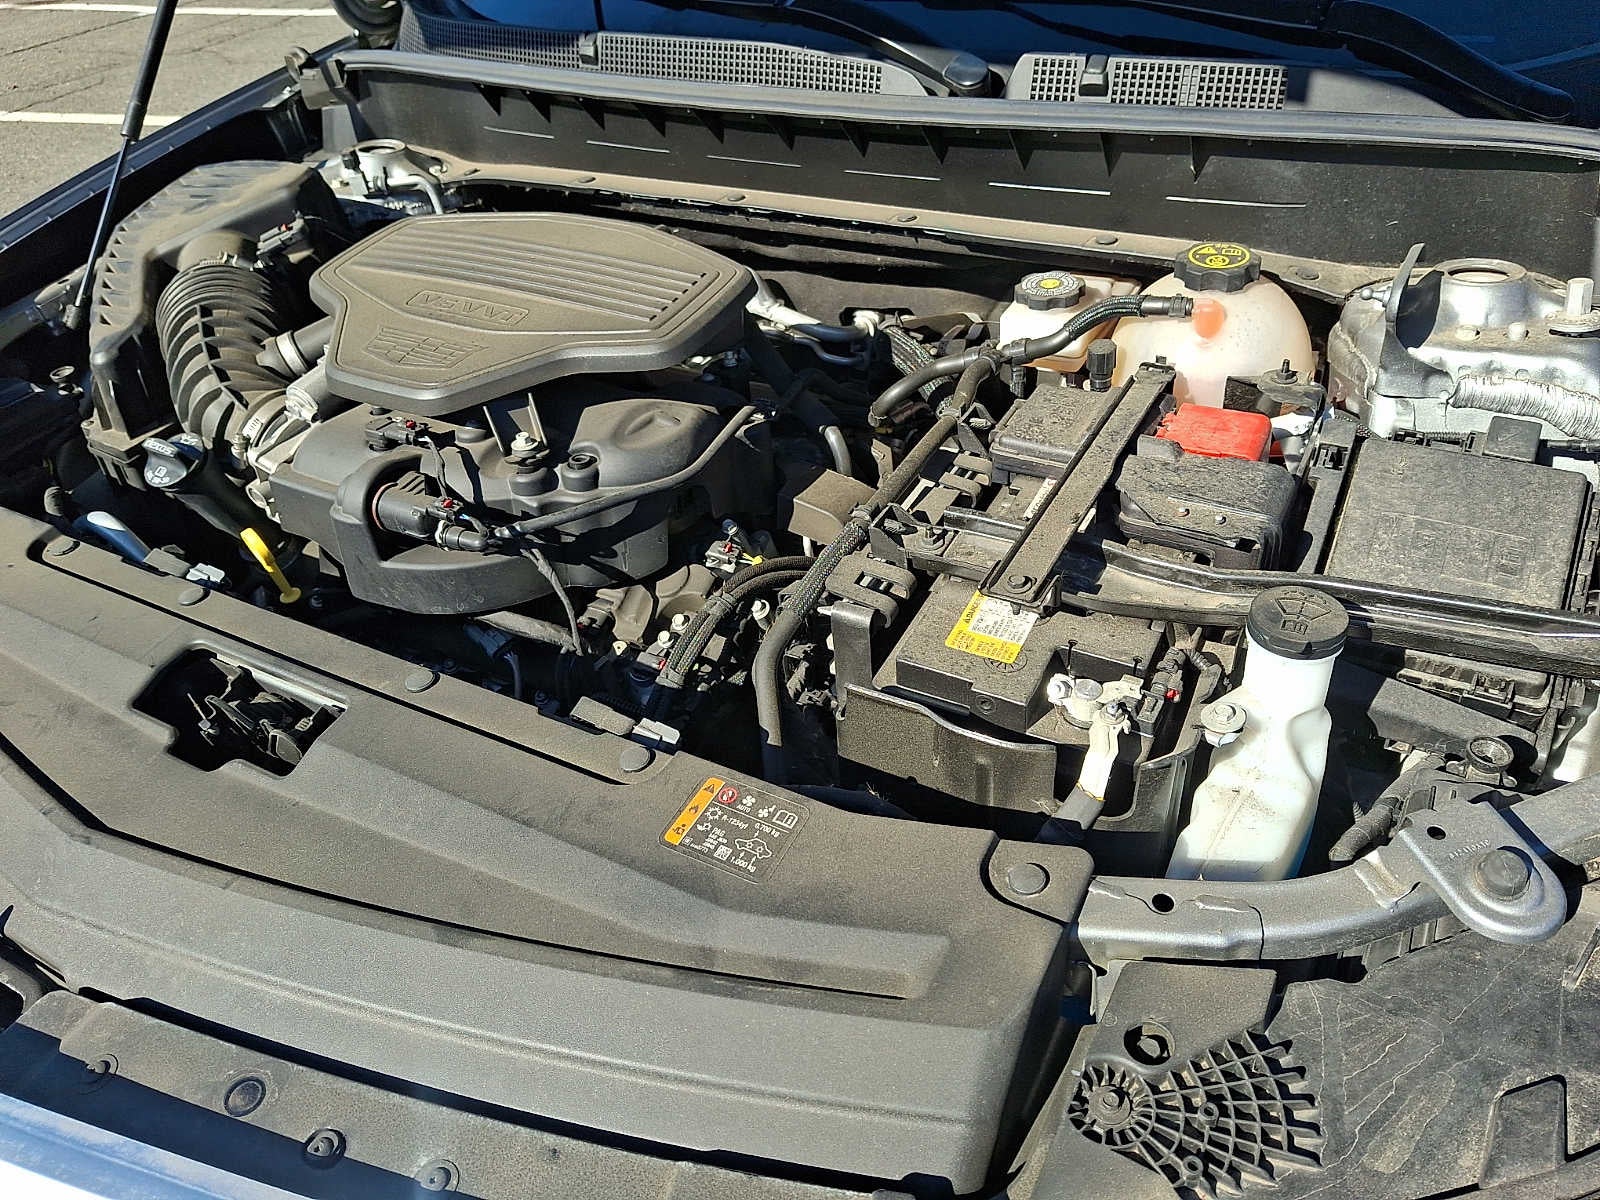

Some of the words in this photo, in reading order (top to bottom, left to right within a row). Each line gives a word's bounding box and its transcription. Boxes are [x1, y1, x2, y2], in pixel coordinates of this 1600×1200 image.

[736, 803, 752, 813] AUTO
[730, 856, 748, 869] 1.000
[746, 862, 757, 873] kg
